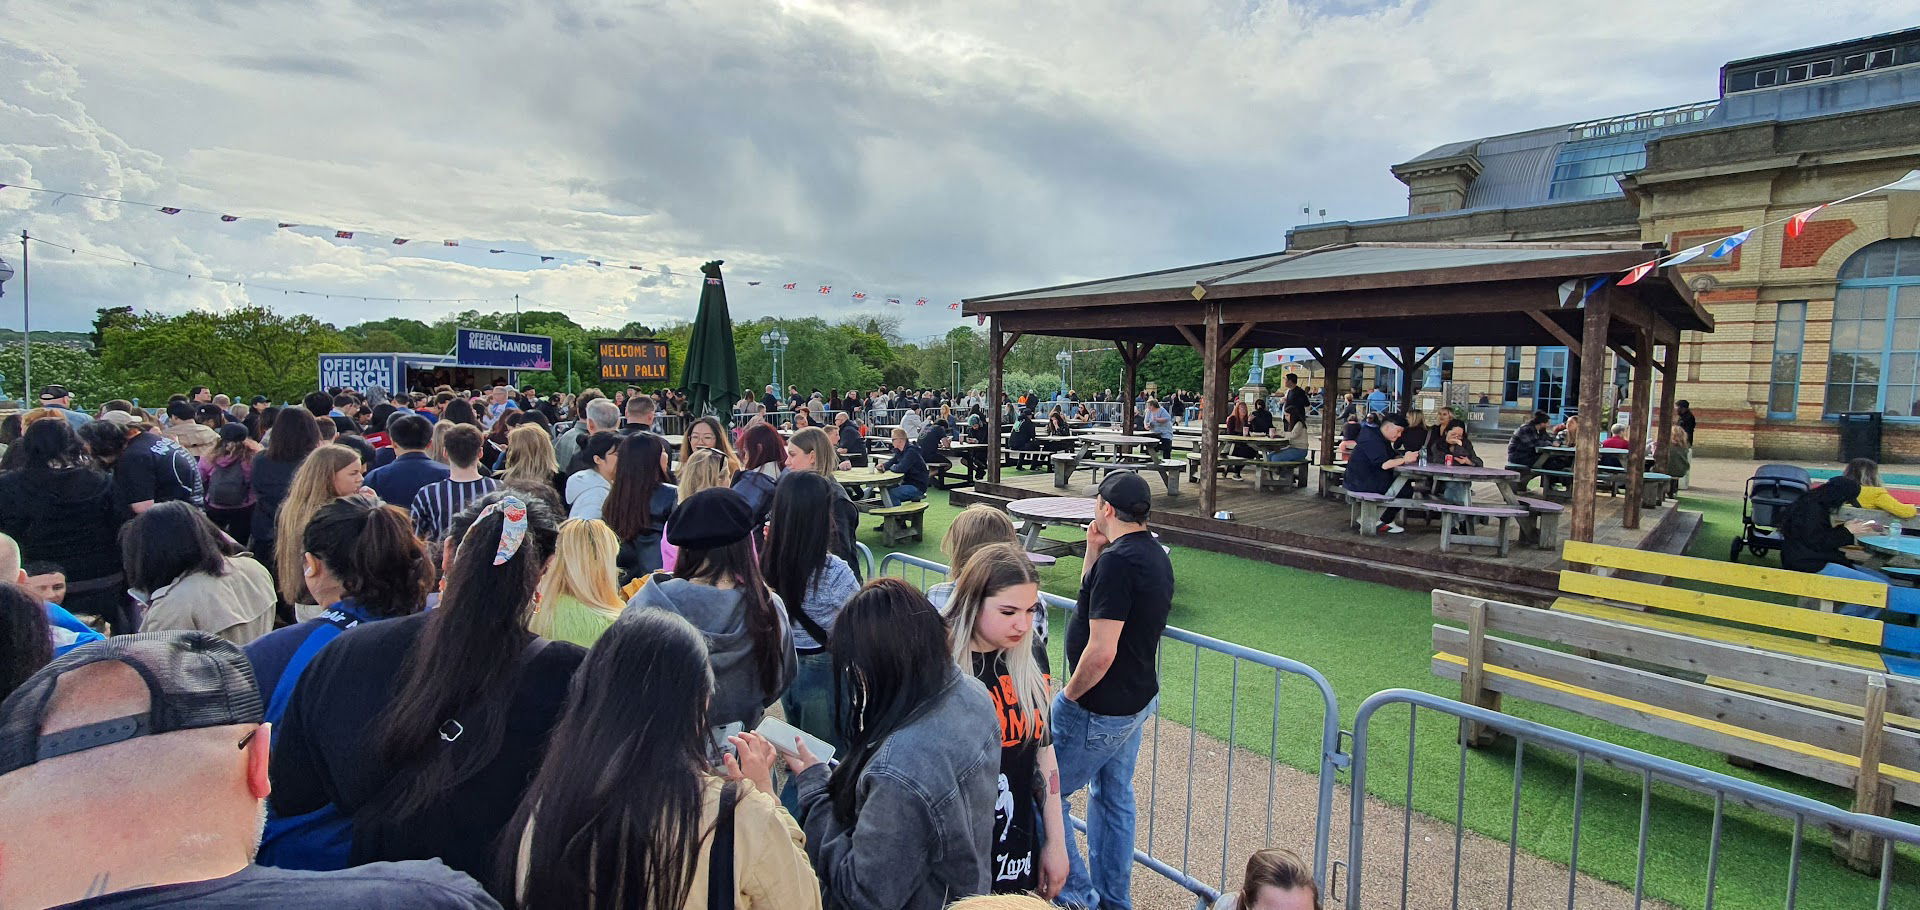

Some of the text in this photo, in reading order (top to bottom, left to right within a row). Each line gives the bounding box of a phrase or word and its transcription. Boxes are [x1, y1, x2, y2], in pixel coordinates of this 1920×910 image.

[468, 332, 502, 341] OFFICIAL
[468, 339, 543, 354] MERCHANDISE
[600, 344, 667, 358] WELCOME TO
[323, 358, 390, 372] OFFICIAL
[602, 364, 666, 378] ALLY PALLY
[323, 371, 391, 387] MERCH
